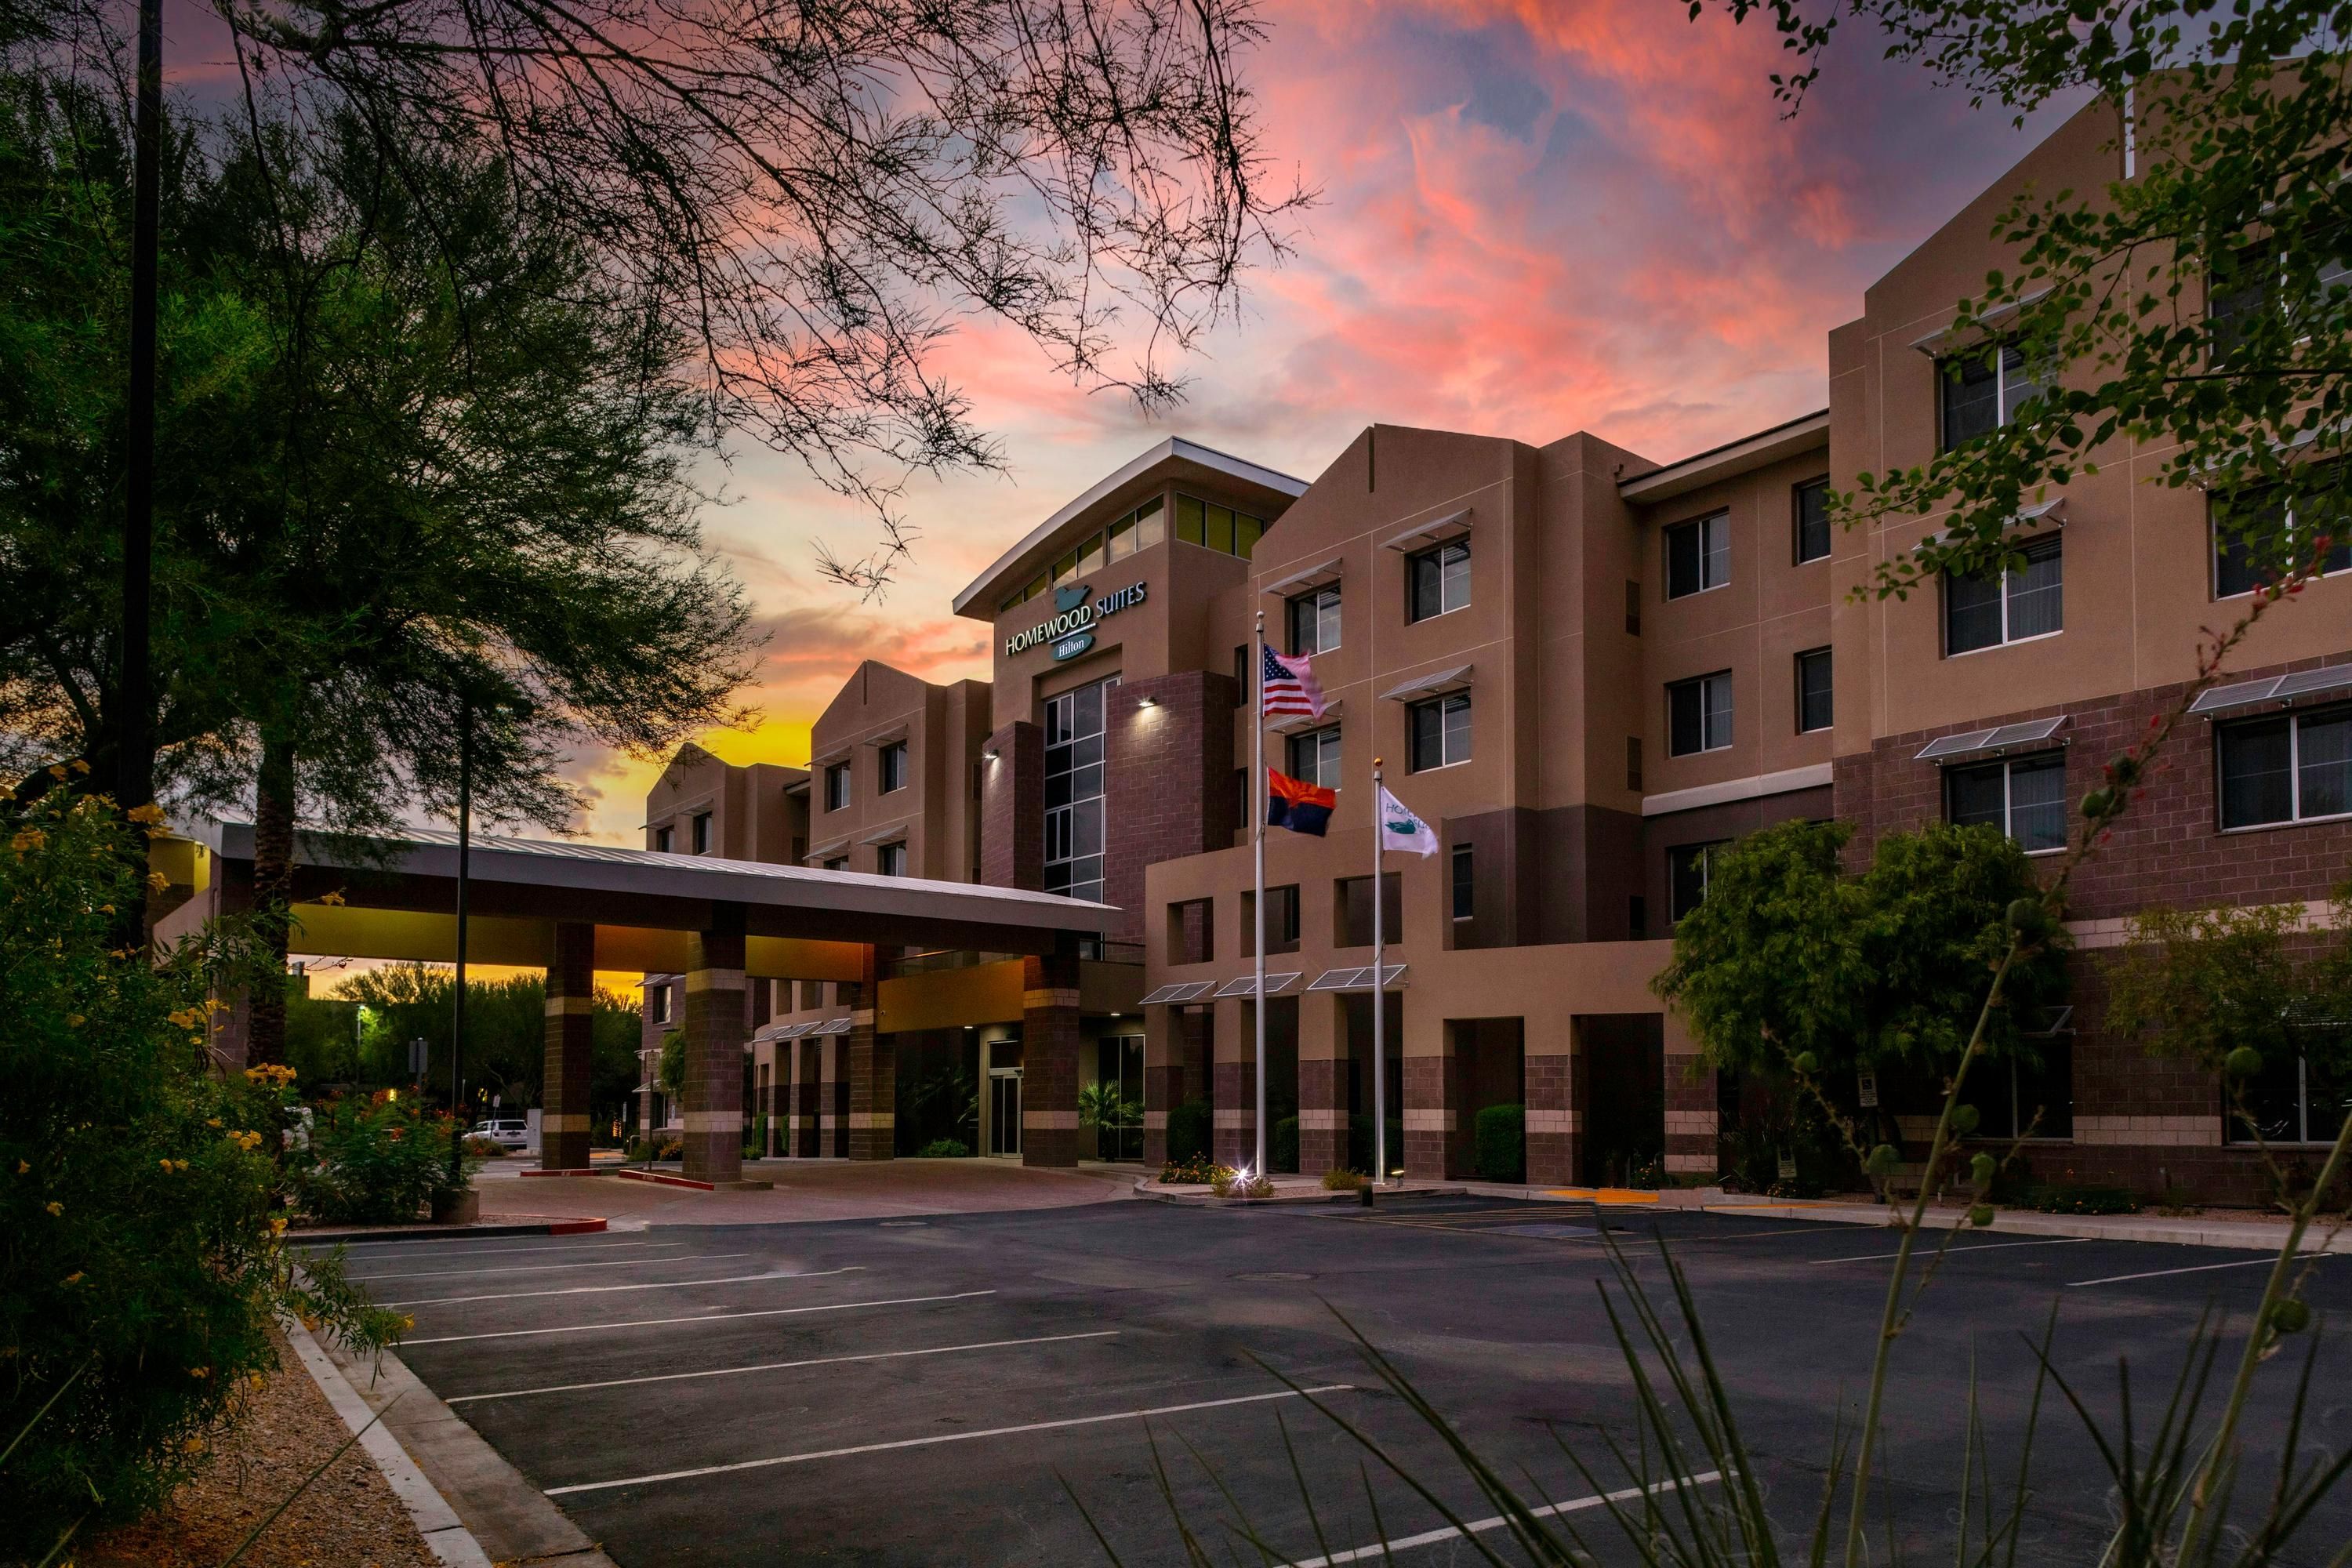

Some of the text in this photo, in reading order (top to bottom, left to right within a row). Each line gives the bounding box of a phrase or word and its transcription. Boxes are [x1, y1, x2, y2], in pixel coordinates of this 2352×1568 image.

[1005, 581, 1145, 656] HOMEWOOD SUITES
[1058, 639, 1084, 658] Hilton
